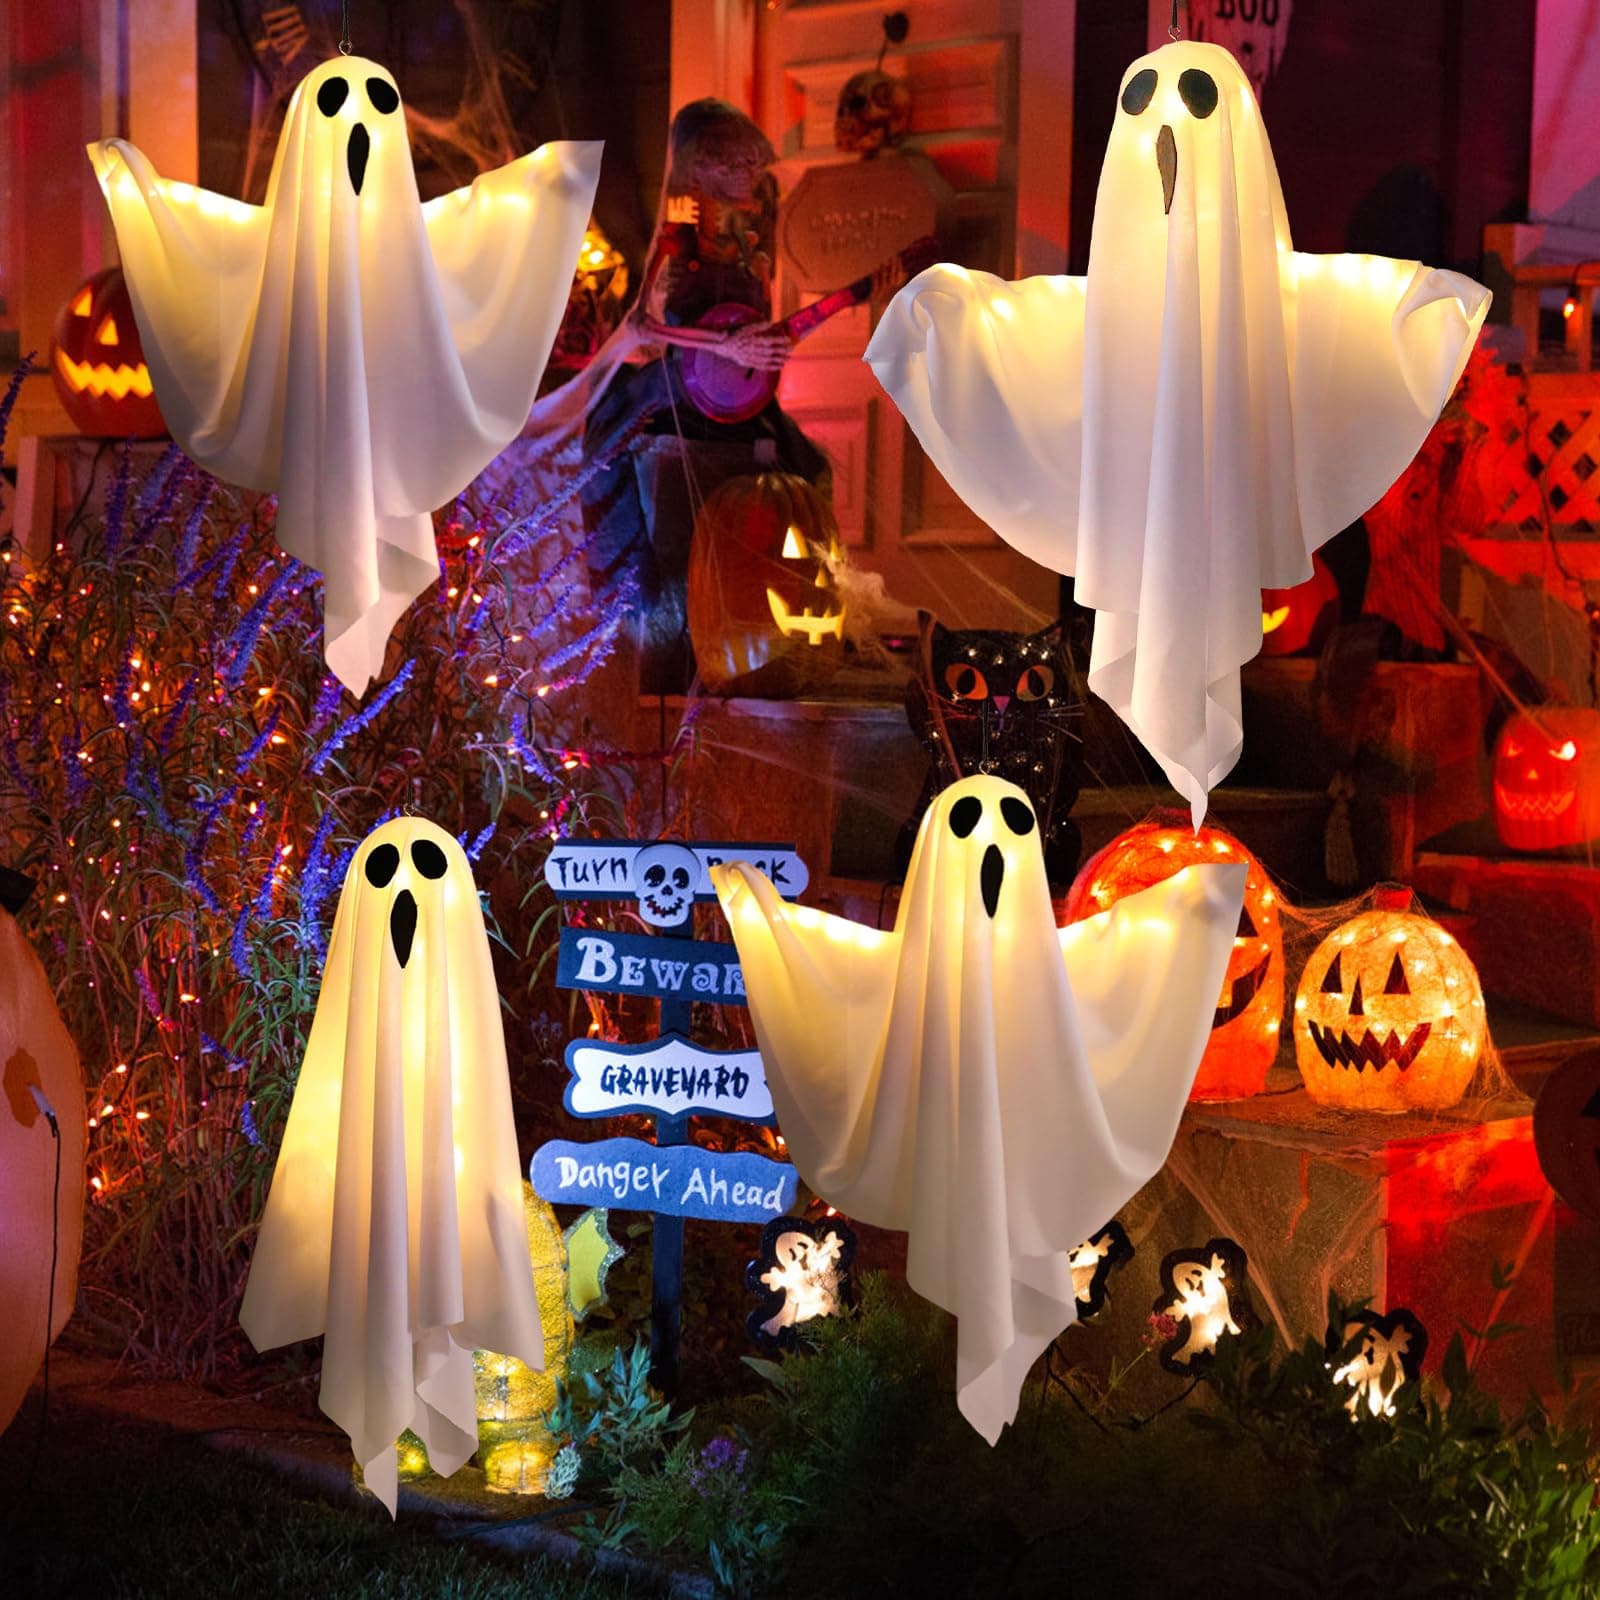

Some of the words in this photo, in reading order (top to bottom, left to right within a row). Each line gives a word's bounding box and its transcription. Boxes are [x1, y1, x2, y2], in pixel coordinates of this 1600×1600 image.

[551, 856, 627, 888] Turn
[600, 1064, 749, 1100] GRAVEYARD
[555, 1156, 670, 1199] Danger
[680, 1168, 786, 1213] Ahead
